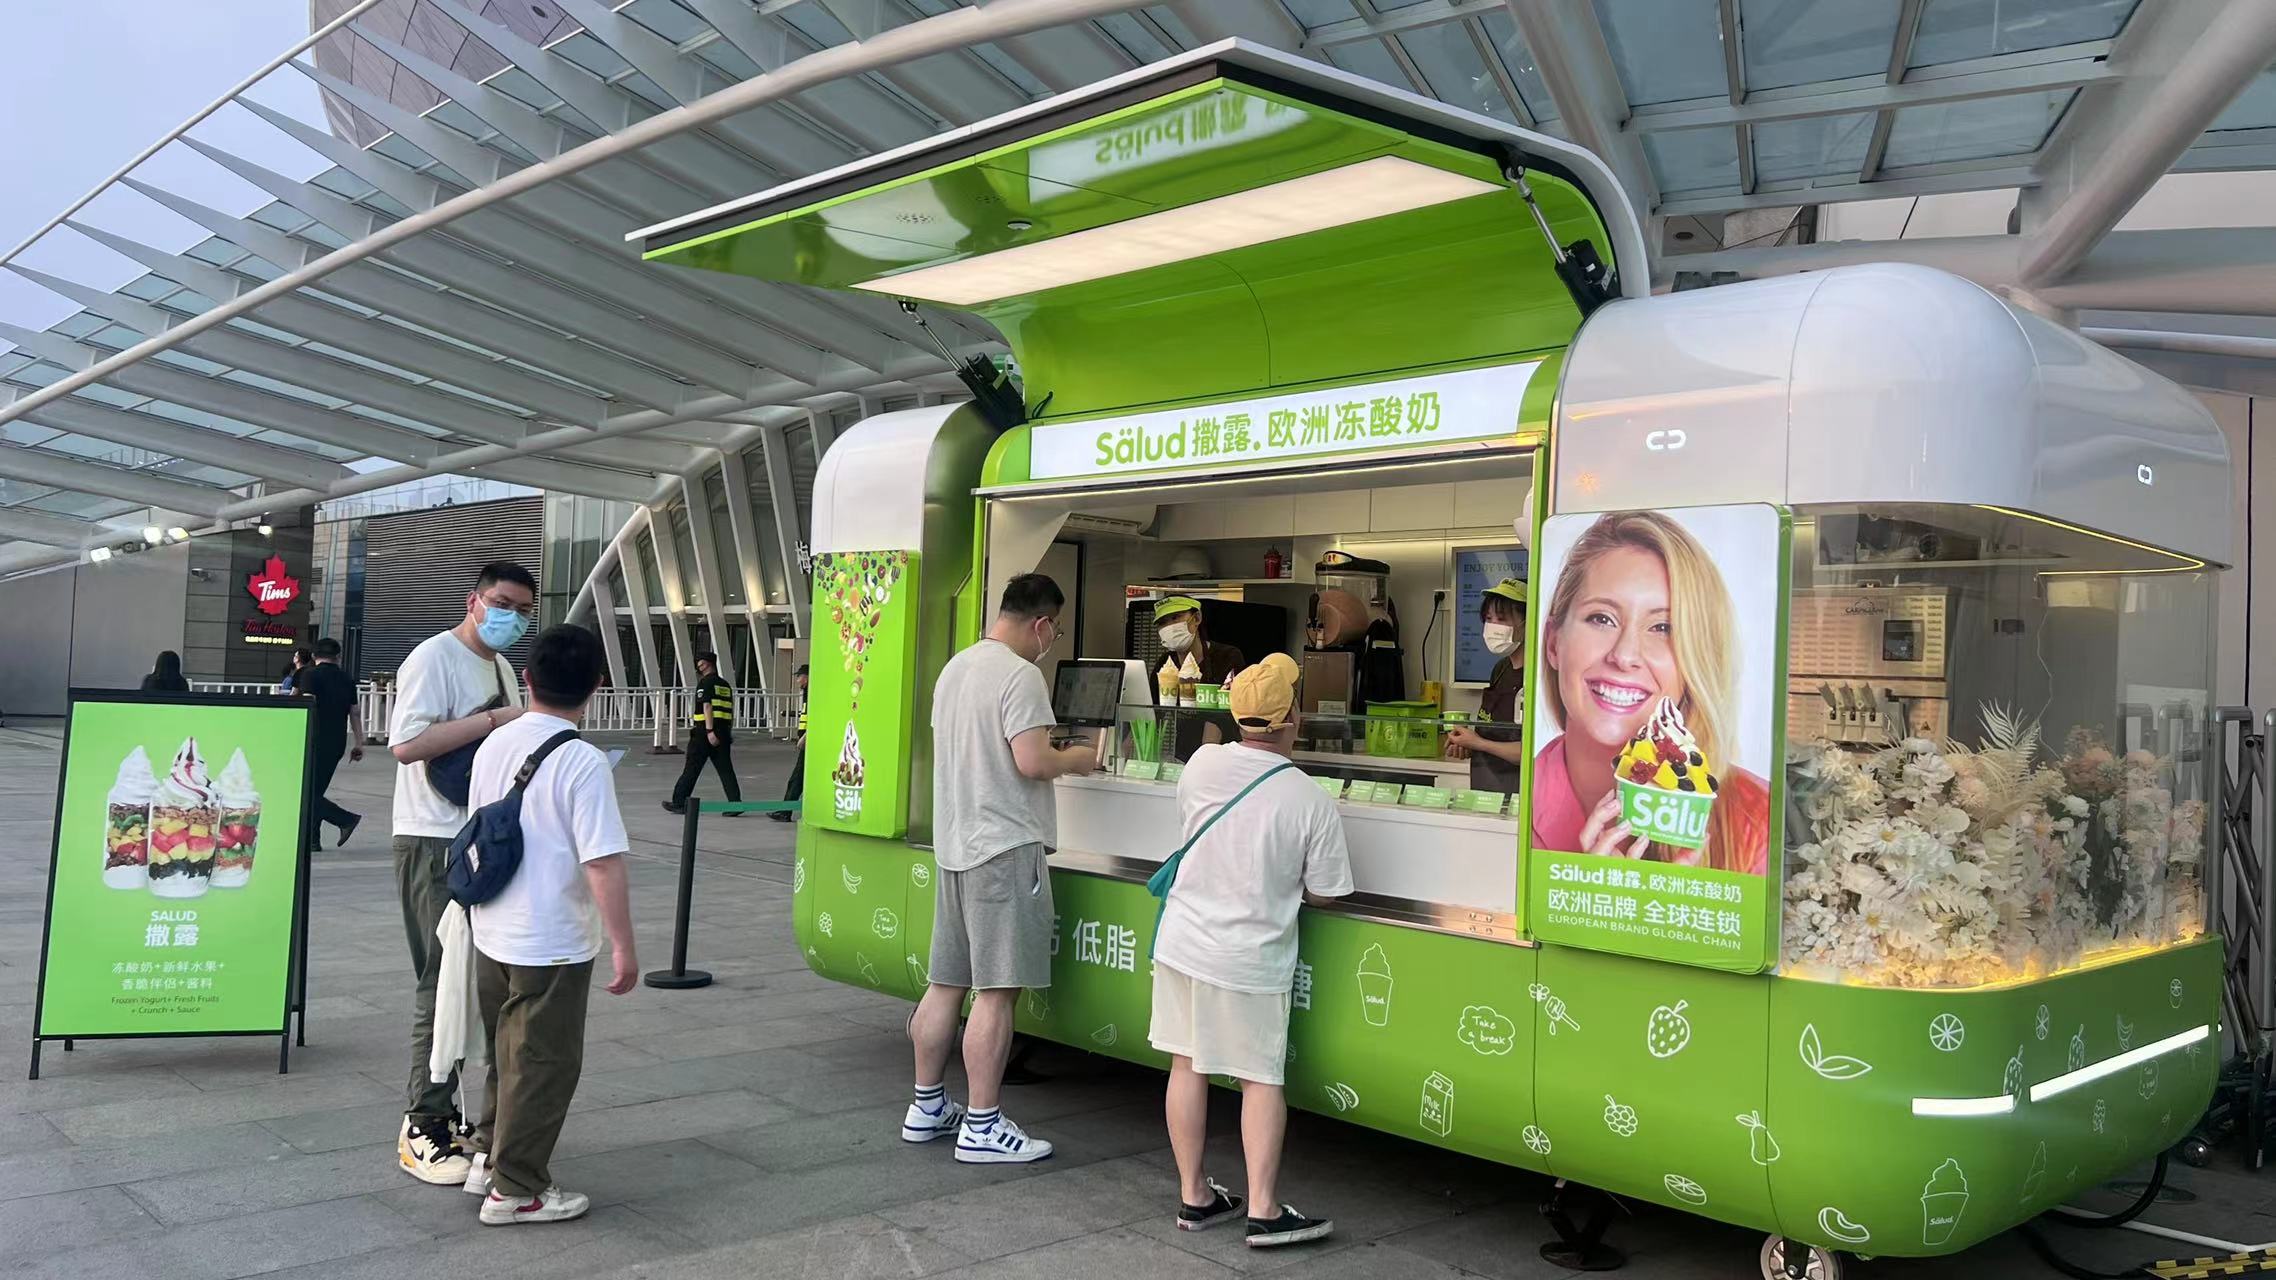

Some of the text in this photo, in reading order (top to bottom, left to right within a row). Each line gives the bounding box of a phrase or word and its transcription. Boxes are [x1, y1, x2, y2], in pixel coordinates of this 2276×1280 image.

[1096, 420, 1186, 466] Sälud
[1464, 561, 1523, 573] ENJOY YOUR
[258, 580, 290, 601] Tims
[1631, 792, 1709, 838] Sälu
[1549, 863, 1604, 885] Sälud
[150, 910, 198, 921] SALUD
[1548, 889, 1741, 937] 欧洲品牌 全球连锁
[144, 923, 200, 947] 撒露
[1548, 914, 1741, 950] EUROPEAN BRAND GLOBAL CHAIN
[1072, 917, 1137, 973] 低脂
[111, 996, 138, 1004] Frozen
[174, 995, 196, 1003] Fresh
[197, 994, 219, 1003] Fruits
[138, 1006, 168, 1014] Crunch
[176, 1006, 201, 1014] Sauce
[1472, 1016, 1496, 1030] Take
[1481, 1031, 1506, 1045] break
